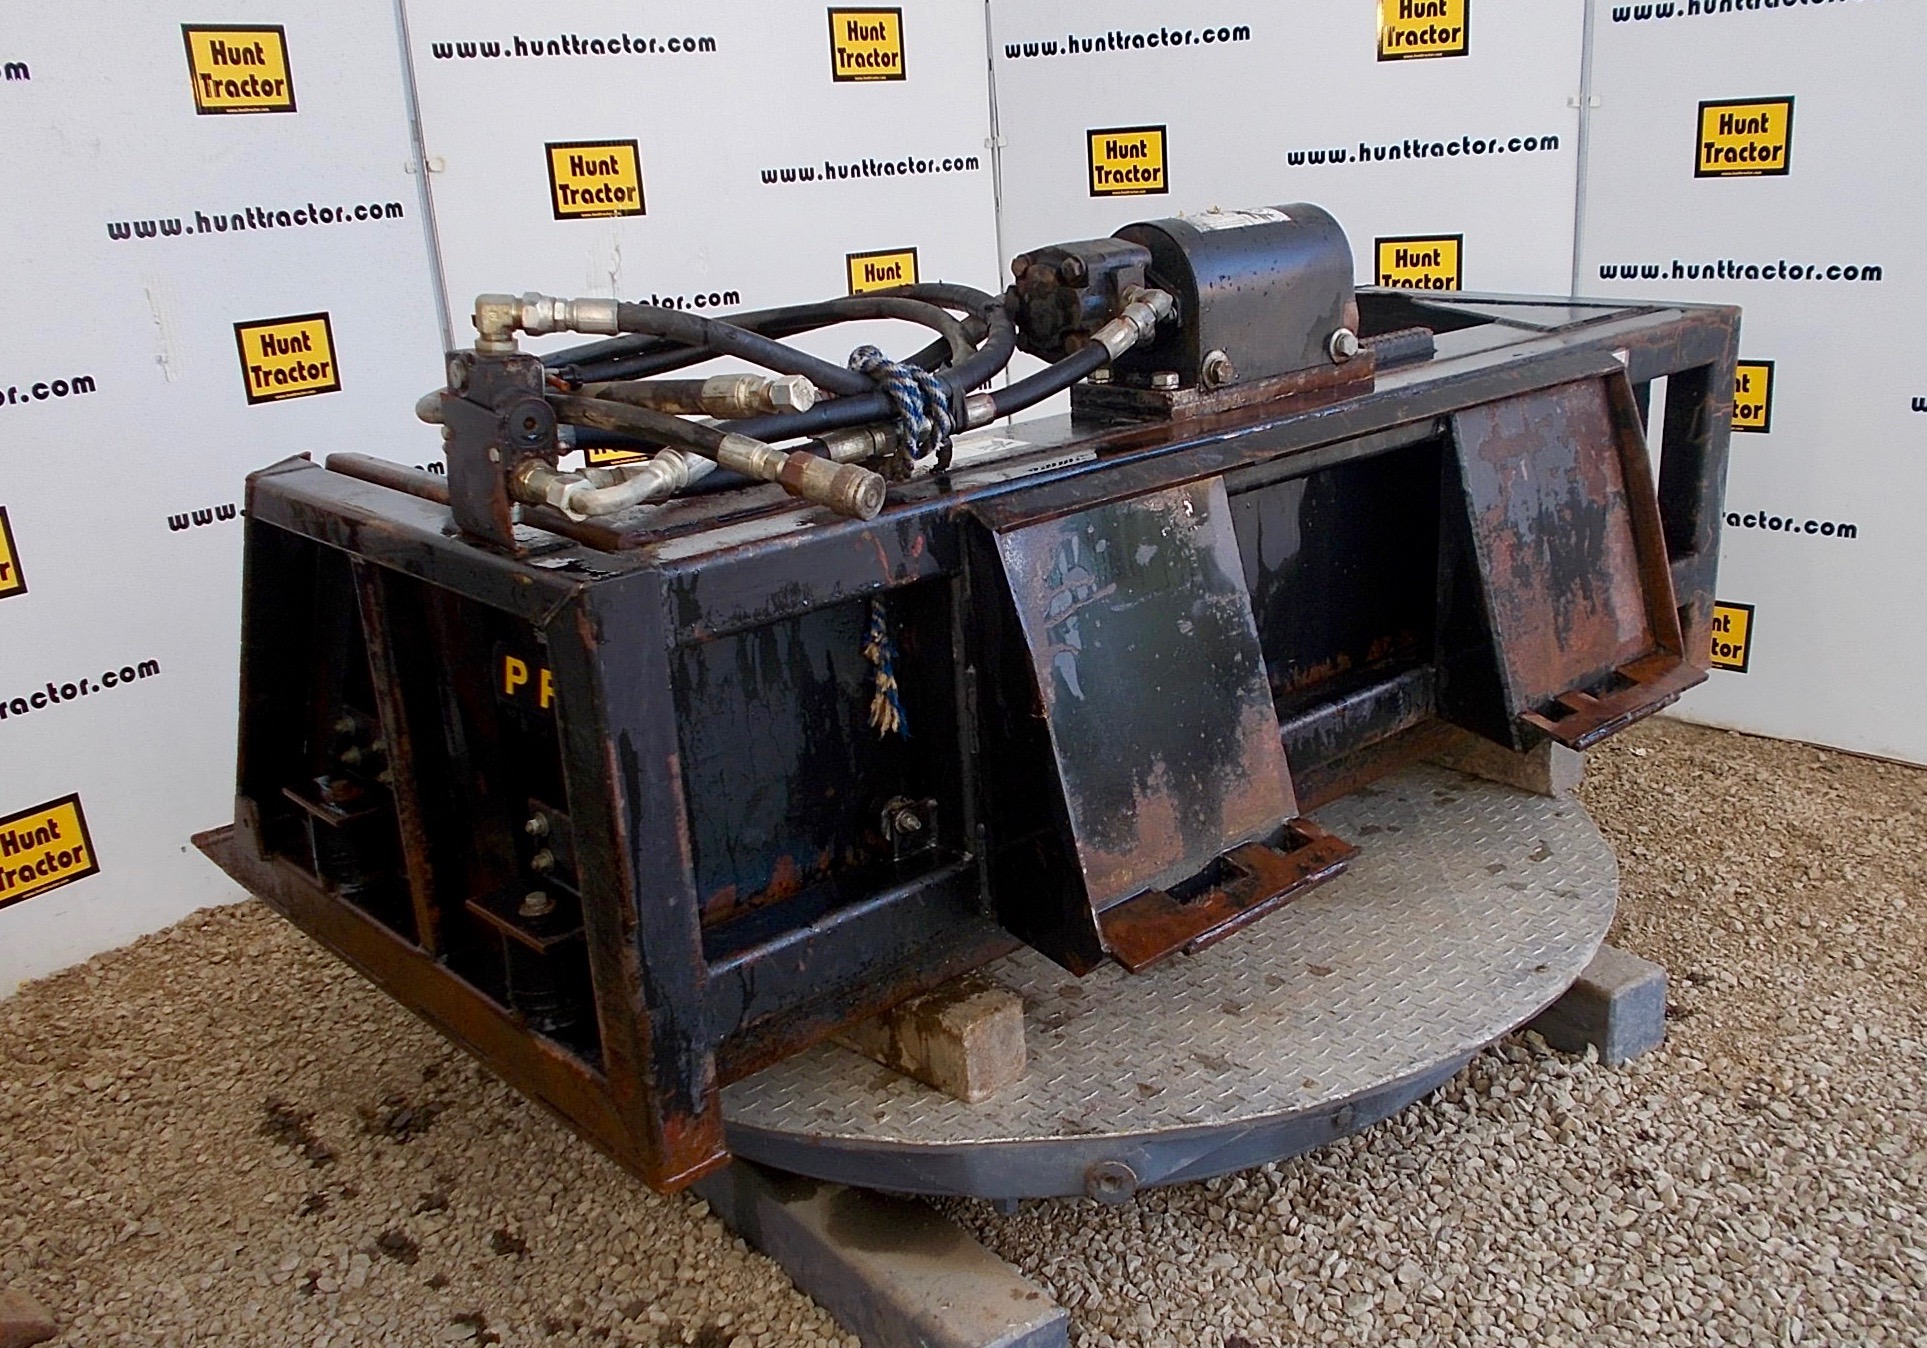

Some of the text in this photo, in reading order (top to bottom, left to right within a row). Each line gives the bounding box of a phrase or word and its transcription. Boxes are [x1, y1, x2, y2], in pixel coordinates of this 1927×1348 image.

[846, 20, 887, 42] Hunt
[1005, 25, 1251, 59] www.hunttractor.com
[209, 39, 266, 66] Hunt
[431, 33, 717, 59] www.hunttractor.com
[837, 47, 899, 68] Tractor
[199, 73, 285, 98] Tractor
[1719, 112, 1769, 135] Hunt
[1105, 139, 1148, 160] Hunt
[1287, 135, 1559, 166] www.hunttractor.com
[1703, 141, 1783, 163] Tractor
[569, 154, 620, 177] Hunt
[761, 156, 979, 185] www.hunttractor.com
[1095, 164, 1161, 185] Tractor
[558, 183, 636, 205] Tractor
[107, 202, 404, 241] www.hunttractor.com
[1395, 248, 1441, 269] Hunt
[1599, 259, 1883, 282] www.hunttractor.com
[864, 261, 902, 283] Hunt
[260, 330, 312, 357] Hunt
[250, 360, 330, 388] Tractor
[0, 375, 97, 405] r.com
[1723, 510, 1858, 539] actor.com
[0, 818, 61, 858] Hunt
